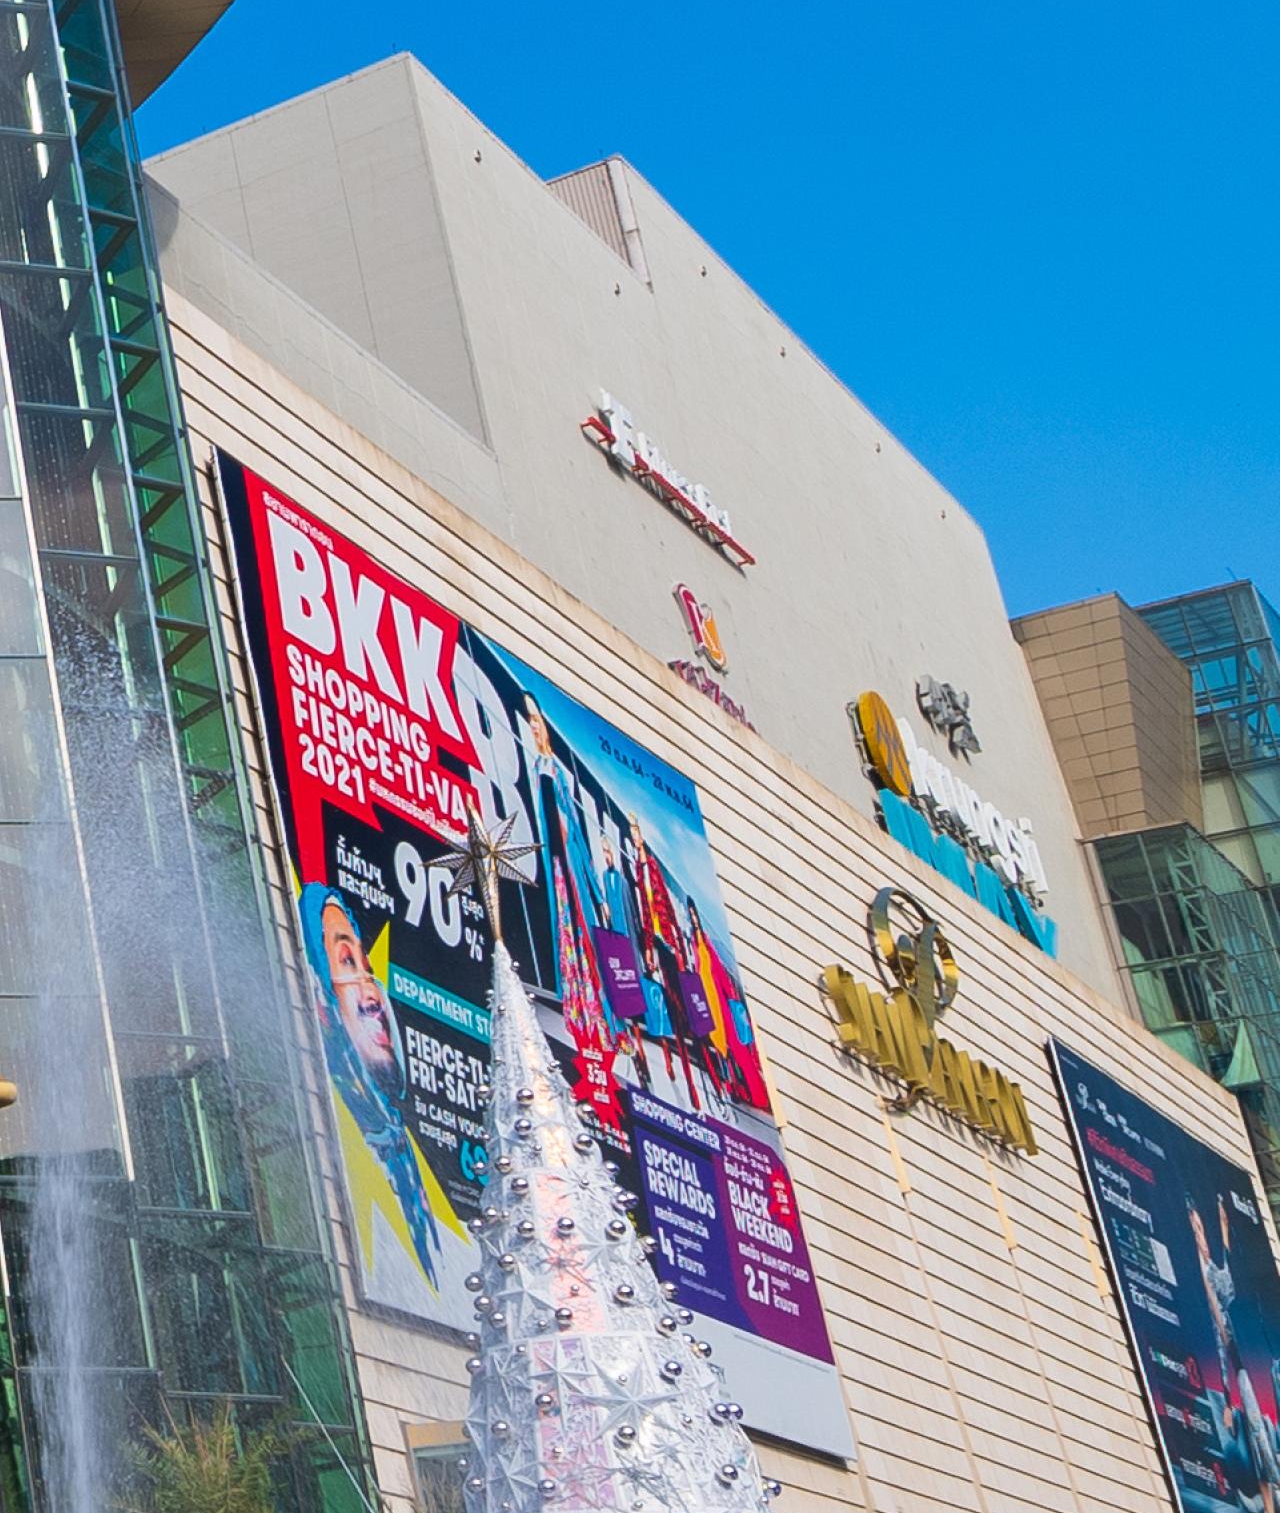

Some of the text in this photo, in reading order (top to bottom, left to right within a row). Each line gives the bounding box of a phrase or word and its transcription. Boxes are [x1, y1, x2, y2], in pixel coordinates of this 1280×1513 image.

[266, 508, 465, 745] BKK
[286, 643, 431, 763] SHOPPING
[291, 685, 469, 828] FIERCE-TI-VA
[298, 733, 366, 805] 2021
[394, 841, 462, 947] 90
[393, 972, 474, 1030] DEPARTMENT
[405, 1026, 490, 1084] FIERCE-TI-
[642, 1139, 702, 1188] SPECIAL
[646, 1165, 717, 1221] REWARDS
[727, 1179, 772, 1222] BLACK
[731, 1205, 794, 1254] WEEKEND
[743, 1263, 771, 1306] 2.7
